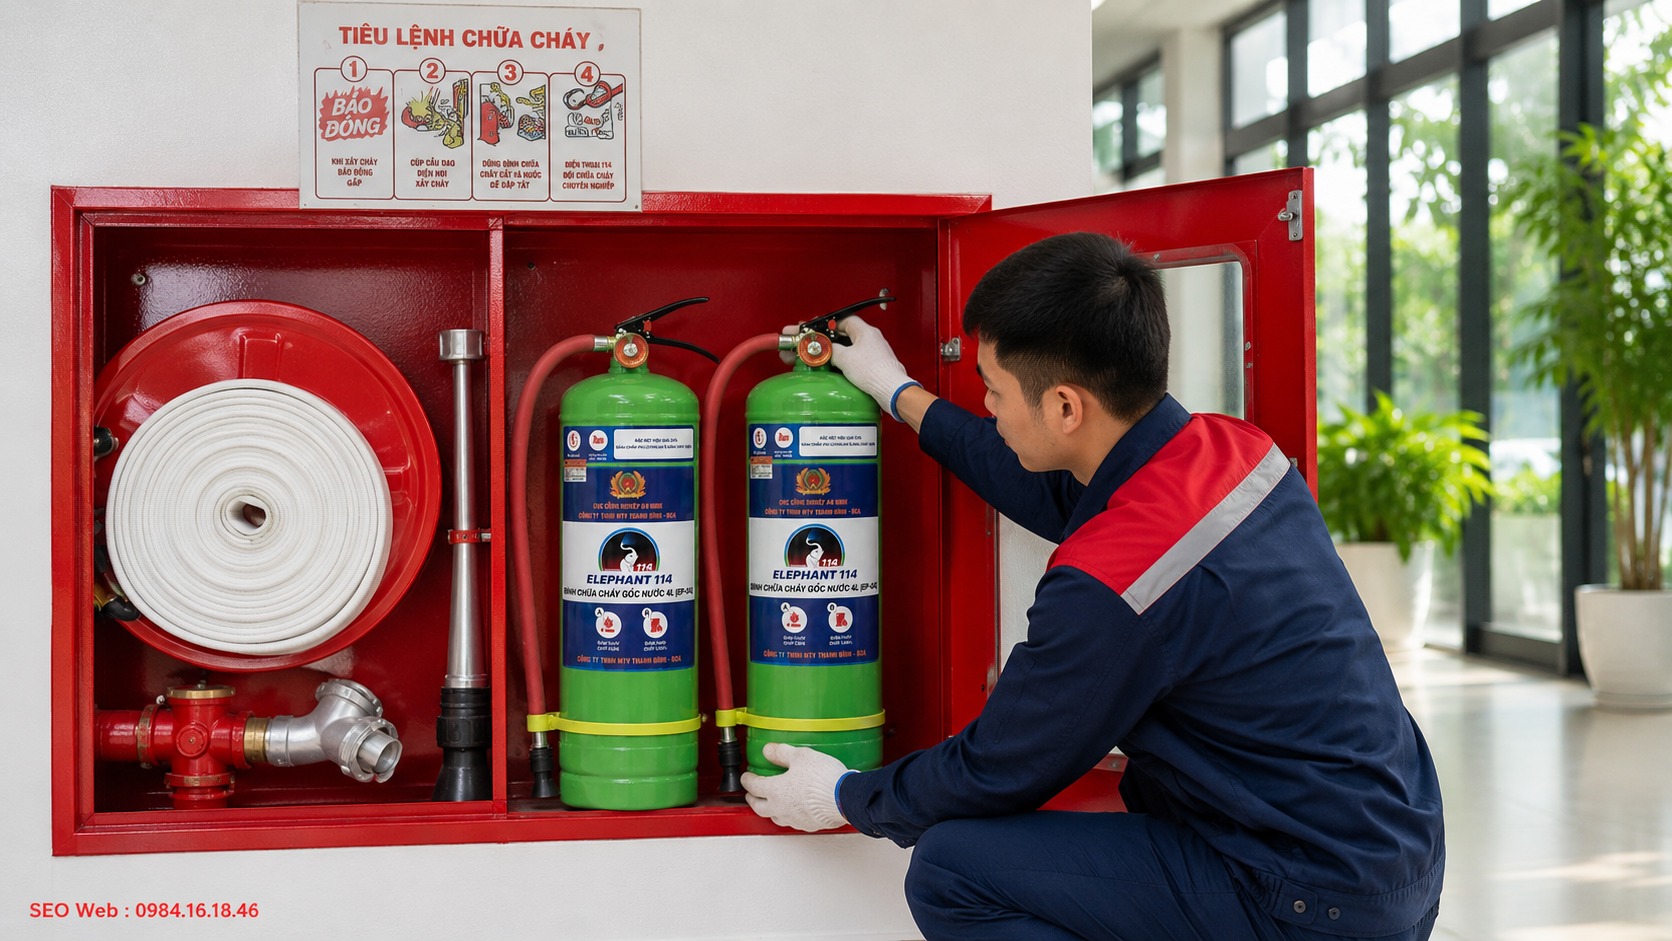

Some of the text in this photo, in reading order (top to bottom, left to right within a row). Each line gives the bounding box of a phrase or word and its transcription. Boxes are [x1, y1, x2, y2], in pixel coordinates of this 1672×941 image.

[339, 23, 388, 45] TIÊU
[396, 24, 454, 49] LỆNH
[462, 26, 524, 48] CHỮA
[530, 27, 591, 49] CHÁY
[349, 61, 358, 78] 1
[426, 62, 439, 79] 2
[504, 64, 517, 81] 3
[580, 65, 593, 82] 4
[331, 91, 373, 116] BÁO
[587, 574, 673, 585] ELEPHANT 114
[773, 570, 858, 580] ELEPHANT 114
[598, 588, 621, 598] CHÁY
[784, 583, 805, 593] CHÁY
